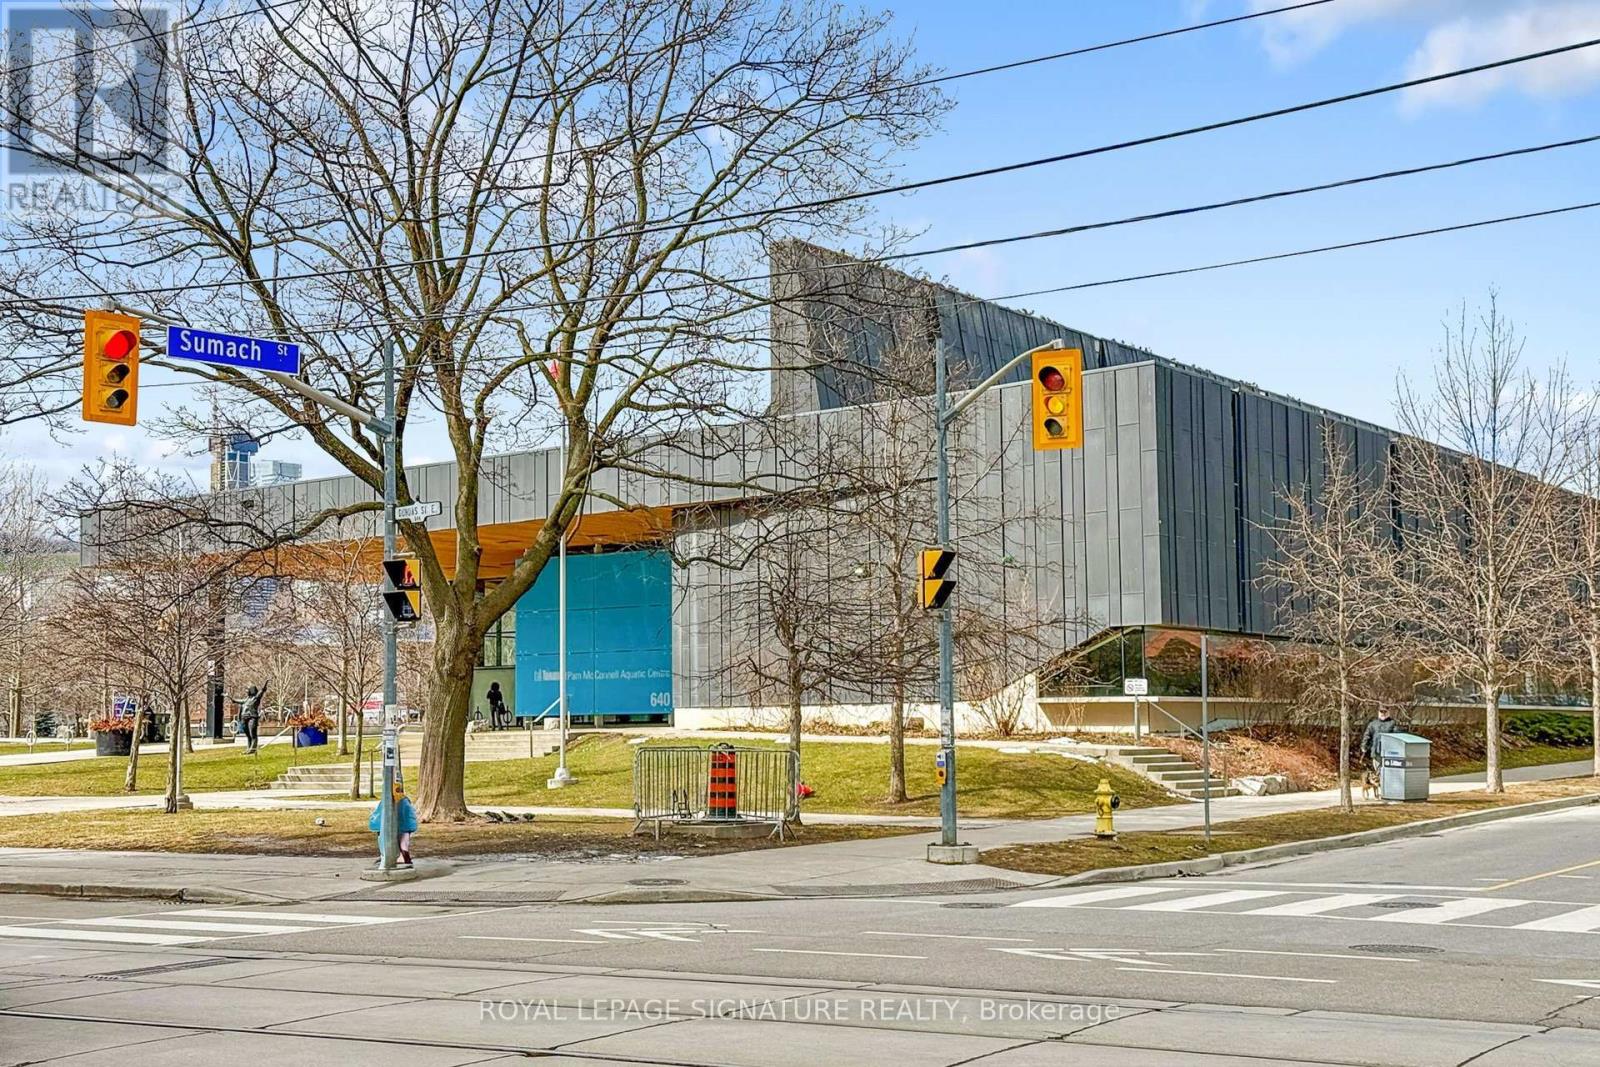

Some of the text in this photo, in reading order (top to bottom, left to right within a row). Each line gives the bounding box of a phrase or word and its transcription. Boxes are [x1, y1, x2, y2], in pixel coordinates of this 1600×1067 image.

[180, 330, 289, 361] Sumach St
[567, 671, 582, 681] Pam
[582, 669, 620, 681] McConnell
[620, 669, 647, 681] Aquatic
[650, 691, 671, 708] 640
